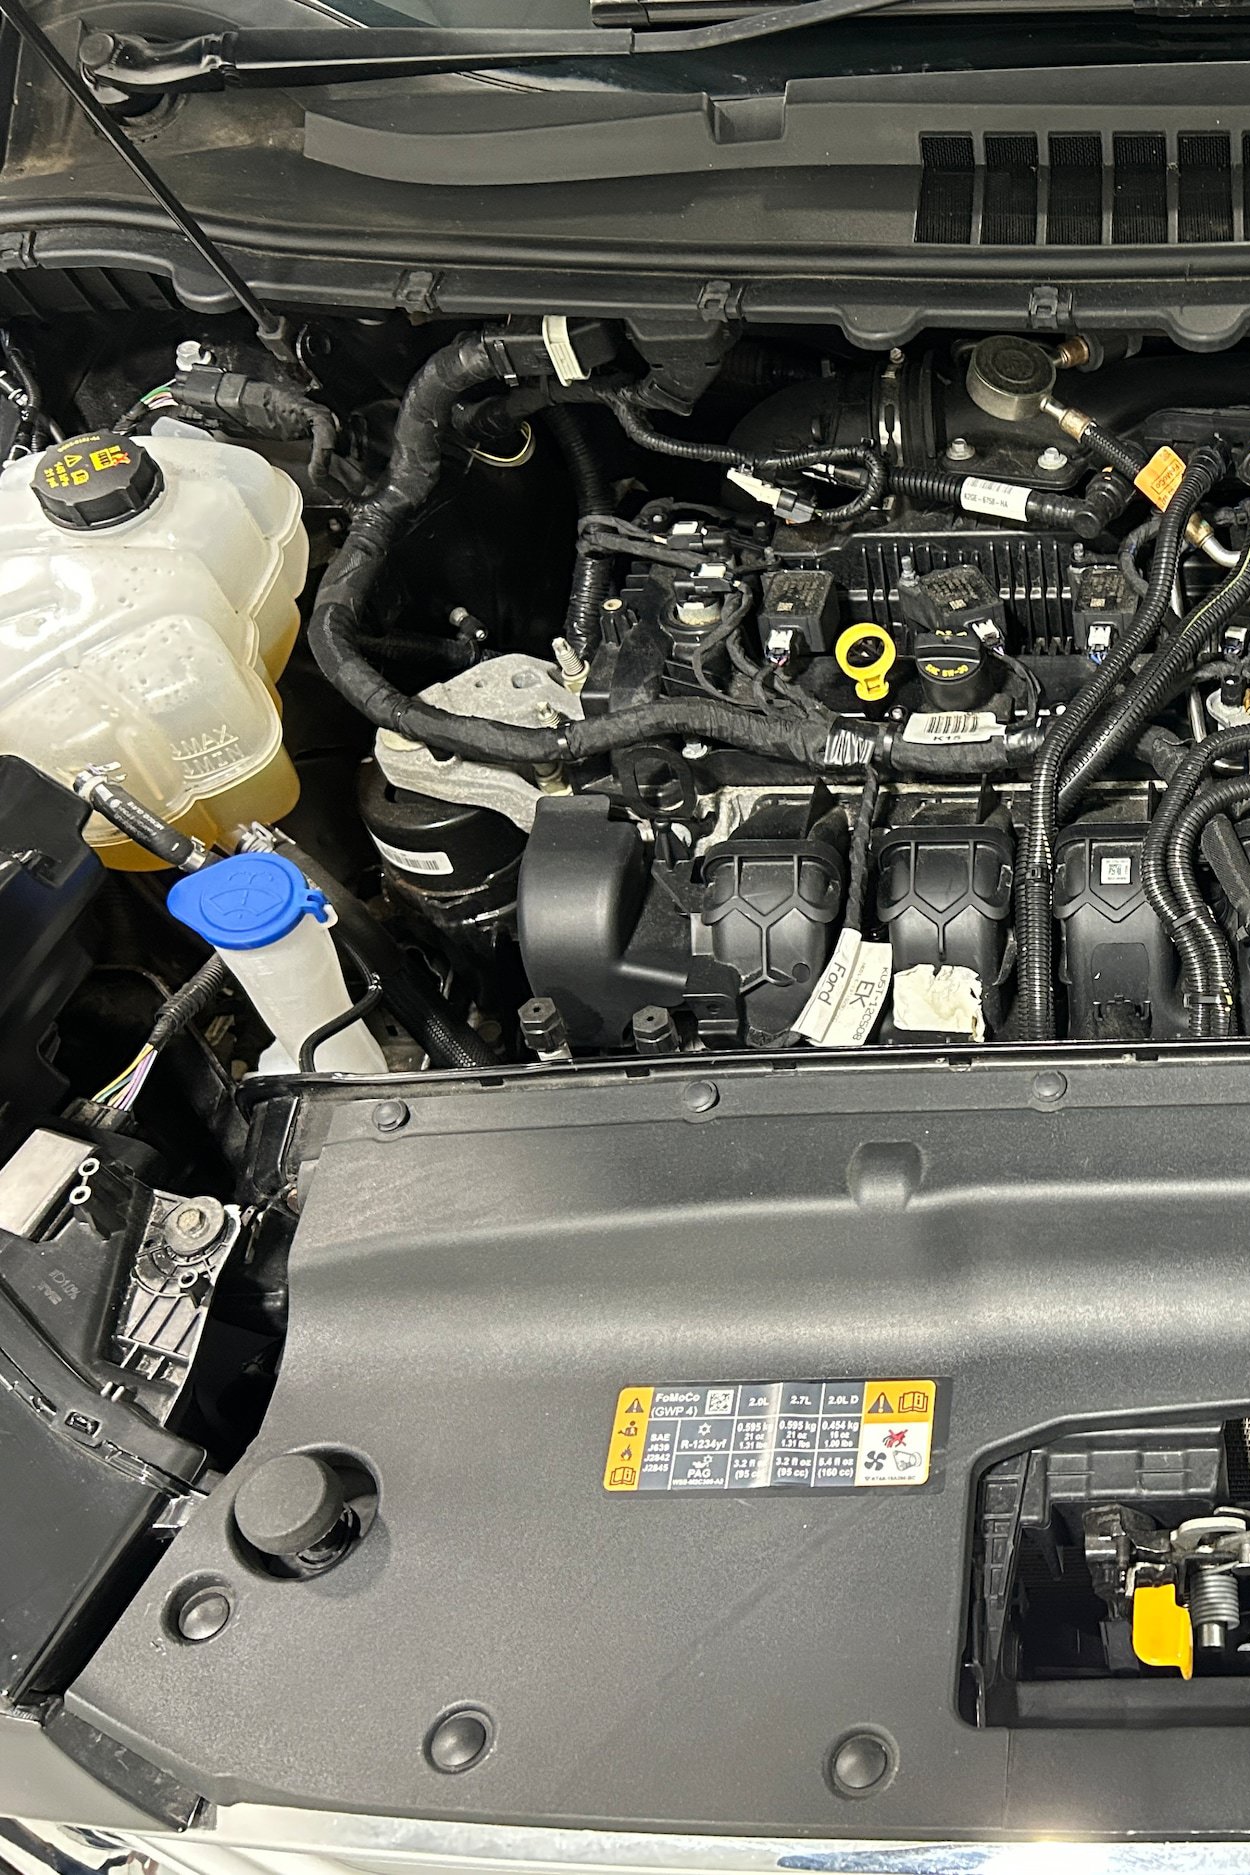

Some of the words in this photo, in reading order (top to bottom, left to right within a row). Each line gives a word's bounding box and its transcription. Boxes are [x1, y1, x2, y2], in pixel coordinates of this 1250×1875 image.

[181, 724, 234, 755] MAX
[193, 743, 245, 774] MIN
[817, 962, 847, 1006] Ford
[849, 980, 876, 1008] EK
[655, 1391, 701, 1403] FoMoCo
[790, 1395, 811, 1406] 2.7L
[828, 1395, 849, 1405] 2.0L
[850, 1395, 859, 1404] D
[650, 1406, 684, 1418] (GWP
[684, 1406, 698, 1417] 4)
[737, 1422, 762, 1432] 0.595
[779, 1420, 804, 1431] 0.595
[804, 1420, 817, 1433] kg
[822, 1420, 846, 1431] 0.454
[846, 1420, 859, 1432] kg
[650, 1433, 671, 1442] SAE
[744, 1432, 754, 1441] 21
[786, 1431, 796, 1439] 21
[680, 1438, 727, 1451] R-1234yf
[781, 1439, 796, 1448] 1.31
[776, 1457, 790, 1466] 3.2
[798, 1458, 811, 1467] oz
[841, 1458, 854, 1466] oz
[687, 1468, 712, 1479] PAG
[793, 1468, 809, 1478] cc)
[838, 1468, 853, 1478] cc)
